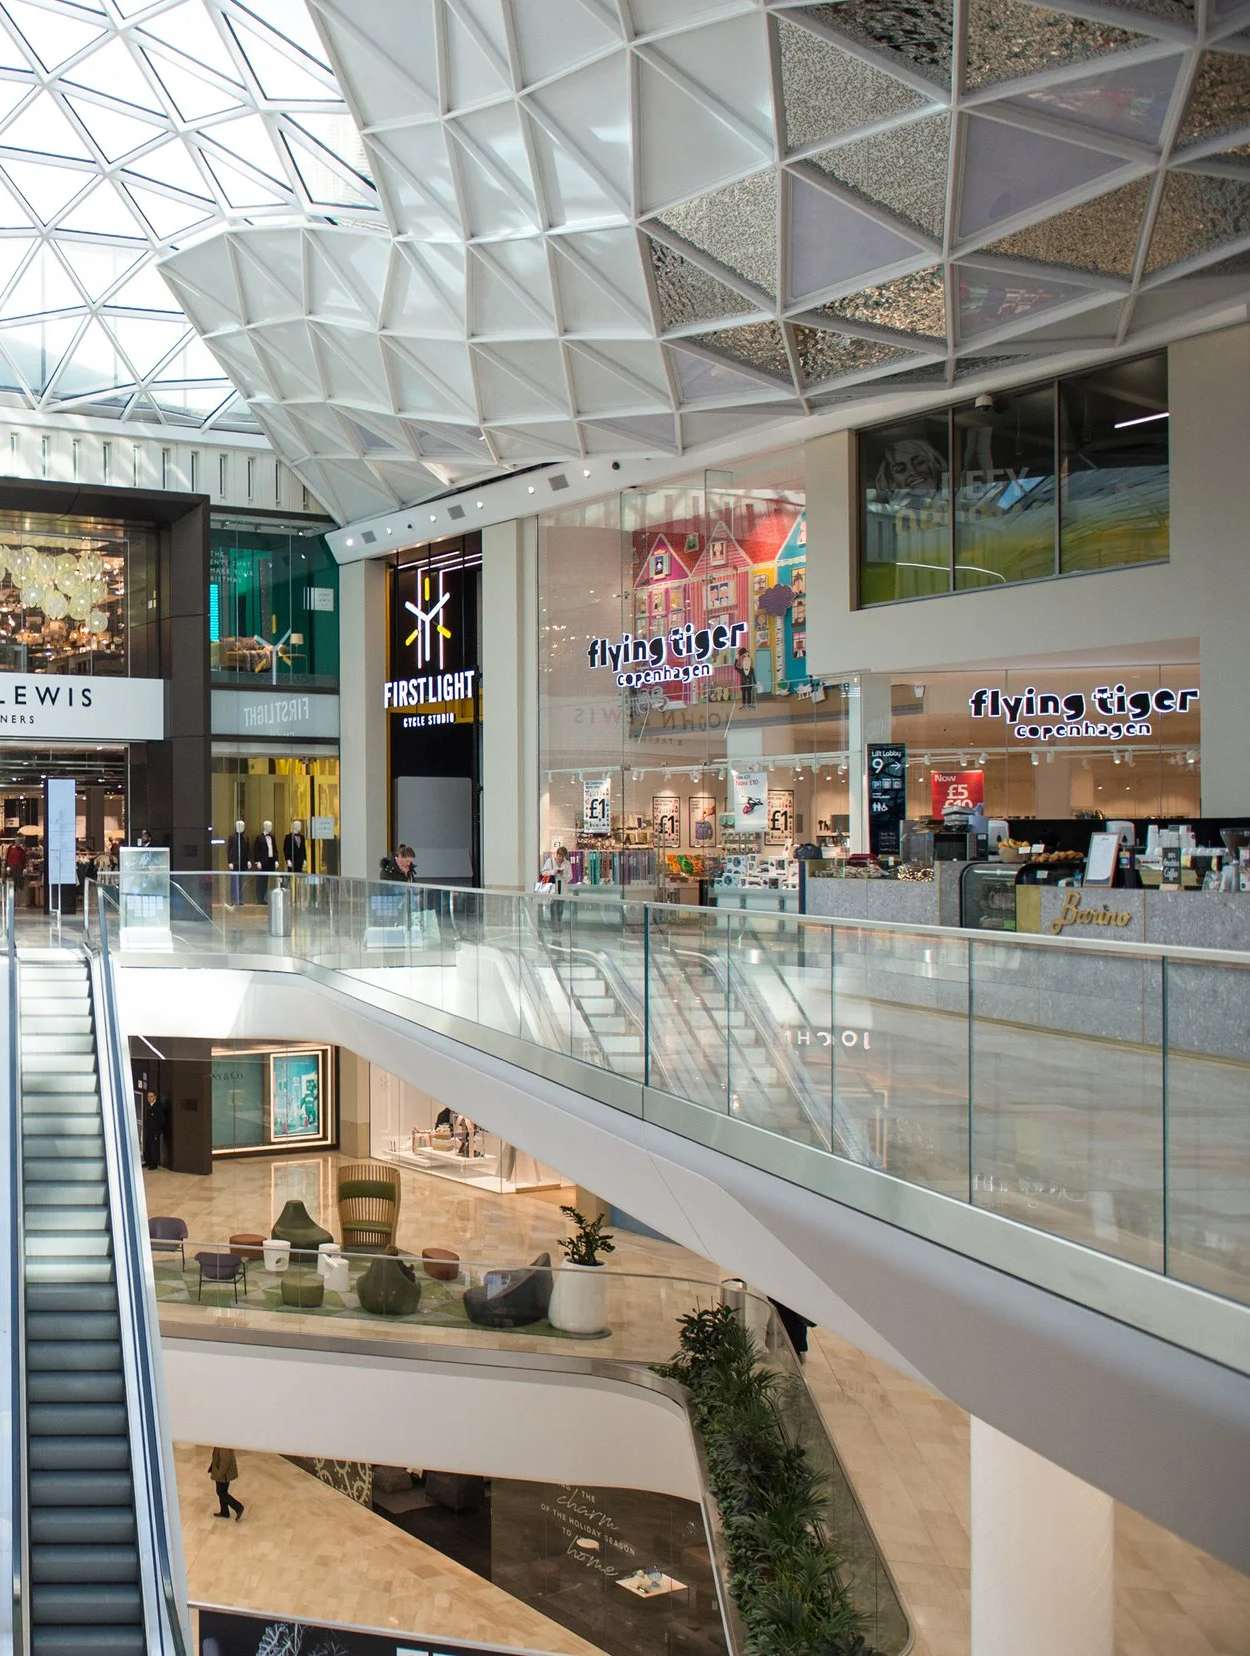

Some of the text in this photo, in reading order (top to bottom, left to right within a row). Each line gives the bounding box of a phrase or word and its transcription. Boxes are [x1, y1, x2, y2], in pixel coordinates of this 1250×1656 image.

[587, 622, 748, 672] flying tiger
[616, 662, 713, 688] copenhagen
[969, 684, 1199, 723] flying tiger
[403, 712, 455, 728] CYCLE STUDIO
[1014, 721, 1152, 740] copenhagen
[883, 750, 902, 758] Lobby
[872, 758, 883, 774] 9
[934, 774, 956, 782] Now
[947, 784, 969, 799] £5
[589, 798, 606, 819] £1
[659, 815, 675, 834] £1
[770, 810, 788, 831] £1
[1052, 891, 1131, 935] Barino
[581, 1490, 596, 1504] THE
[556, 1488, 619, 1530] charm
[540, 1503, 636, 1557] OF THE HOLIDAY SEASON
[561, 1526, 572, 1537] TO
[566, 1535, 619, 1576] home
